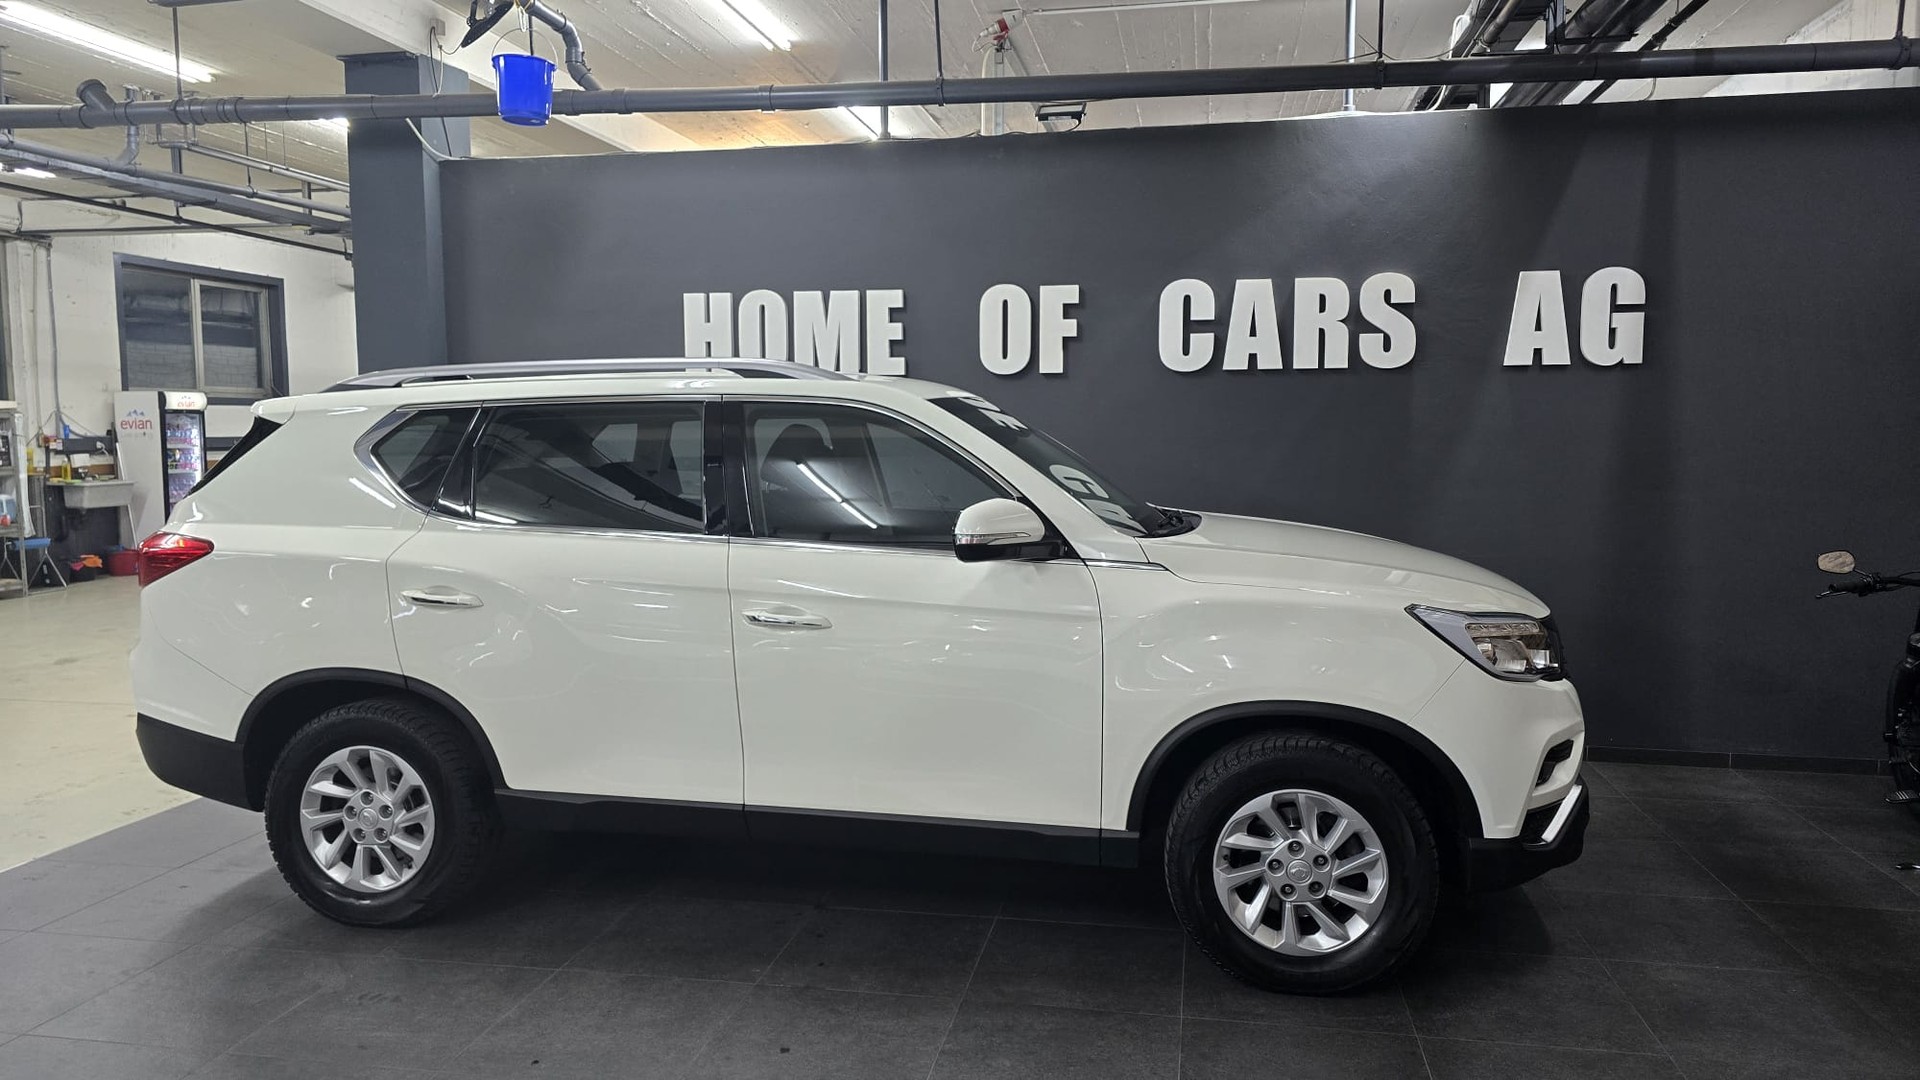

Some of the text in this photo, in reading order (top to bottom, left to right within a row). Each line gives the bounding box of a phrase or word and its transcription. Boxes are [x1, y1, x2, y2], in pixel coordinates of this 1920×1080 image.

[683, 266, 1646, 375] HOME OF CARS AG
[120, 417, 153, 430] evian
